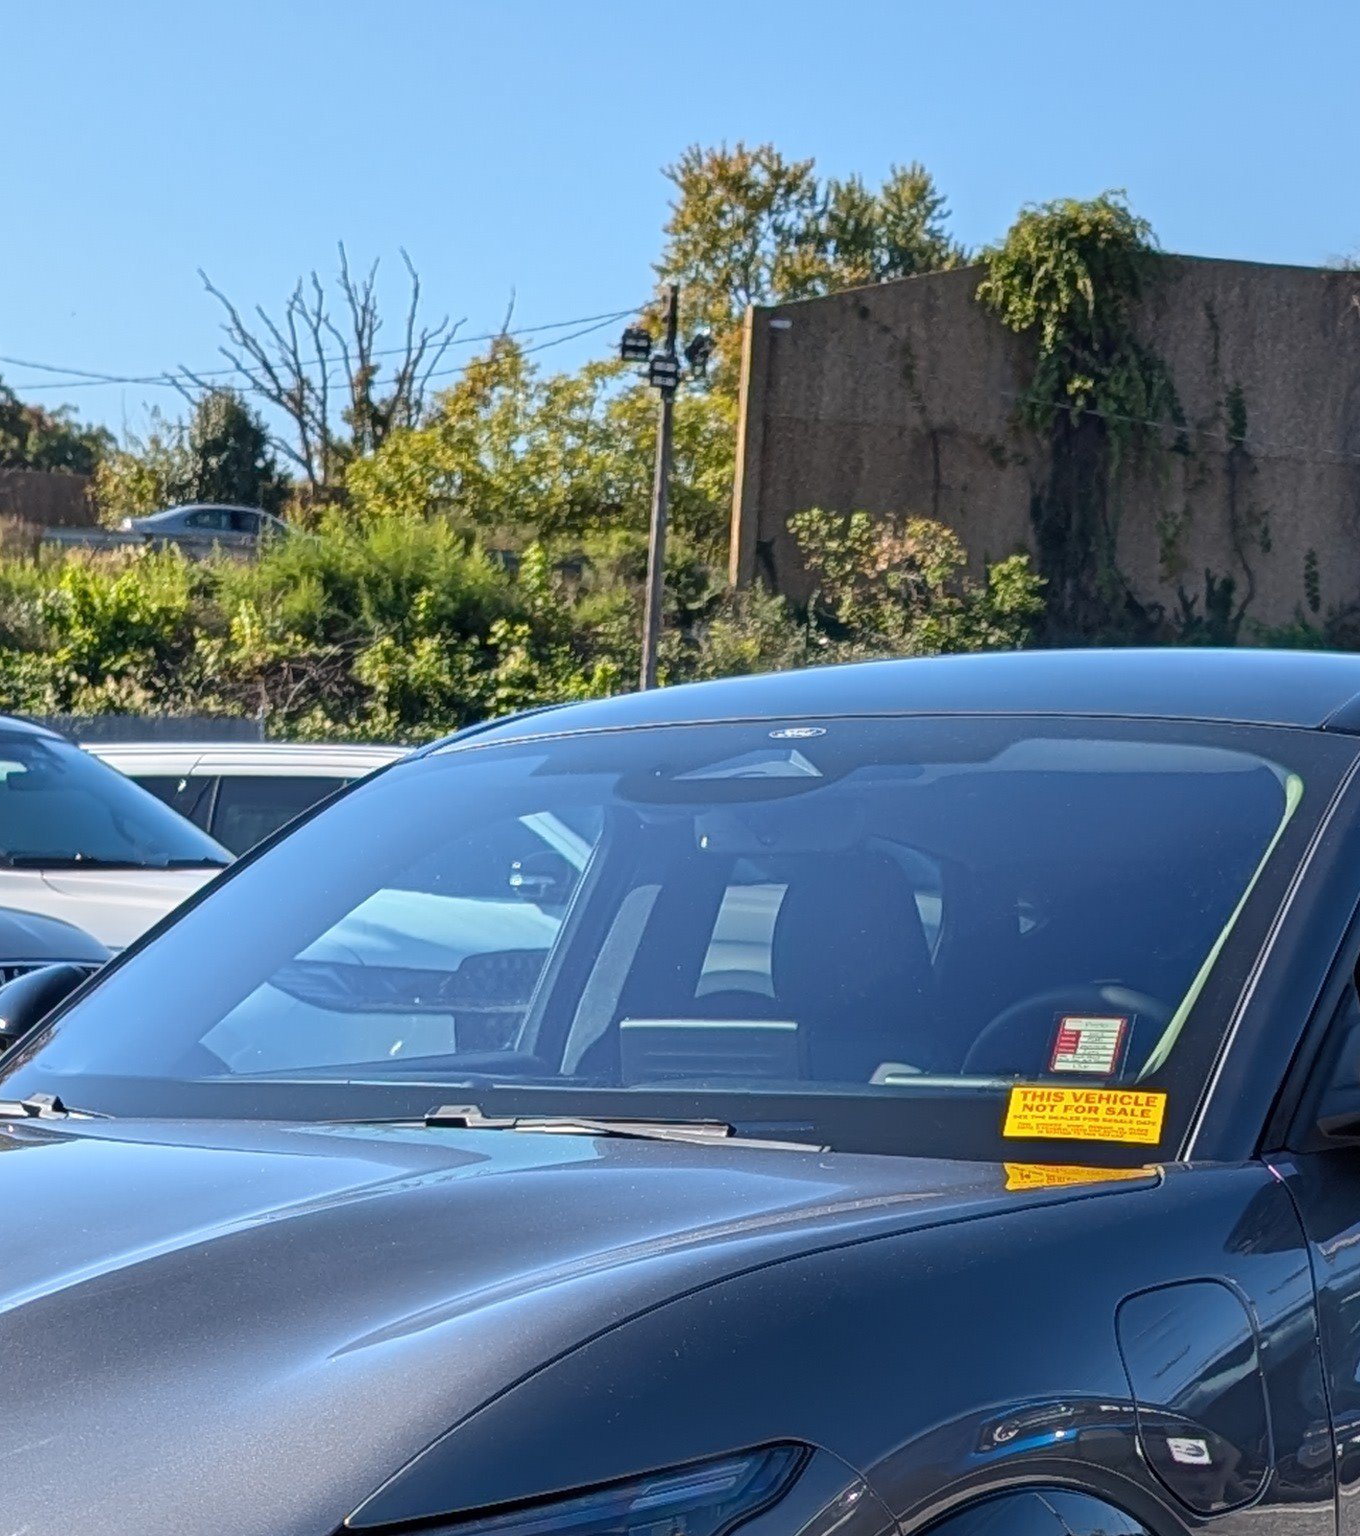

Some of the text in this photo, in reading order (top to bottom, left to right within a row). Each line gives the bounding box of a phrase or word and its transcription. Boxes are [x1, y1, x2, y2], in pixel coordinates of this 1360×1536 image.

[1020, 1090, 1158, 1108] THIS VEHICLE
[1022, 1103, 1152, 1118] NOT FOR SALE
